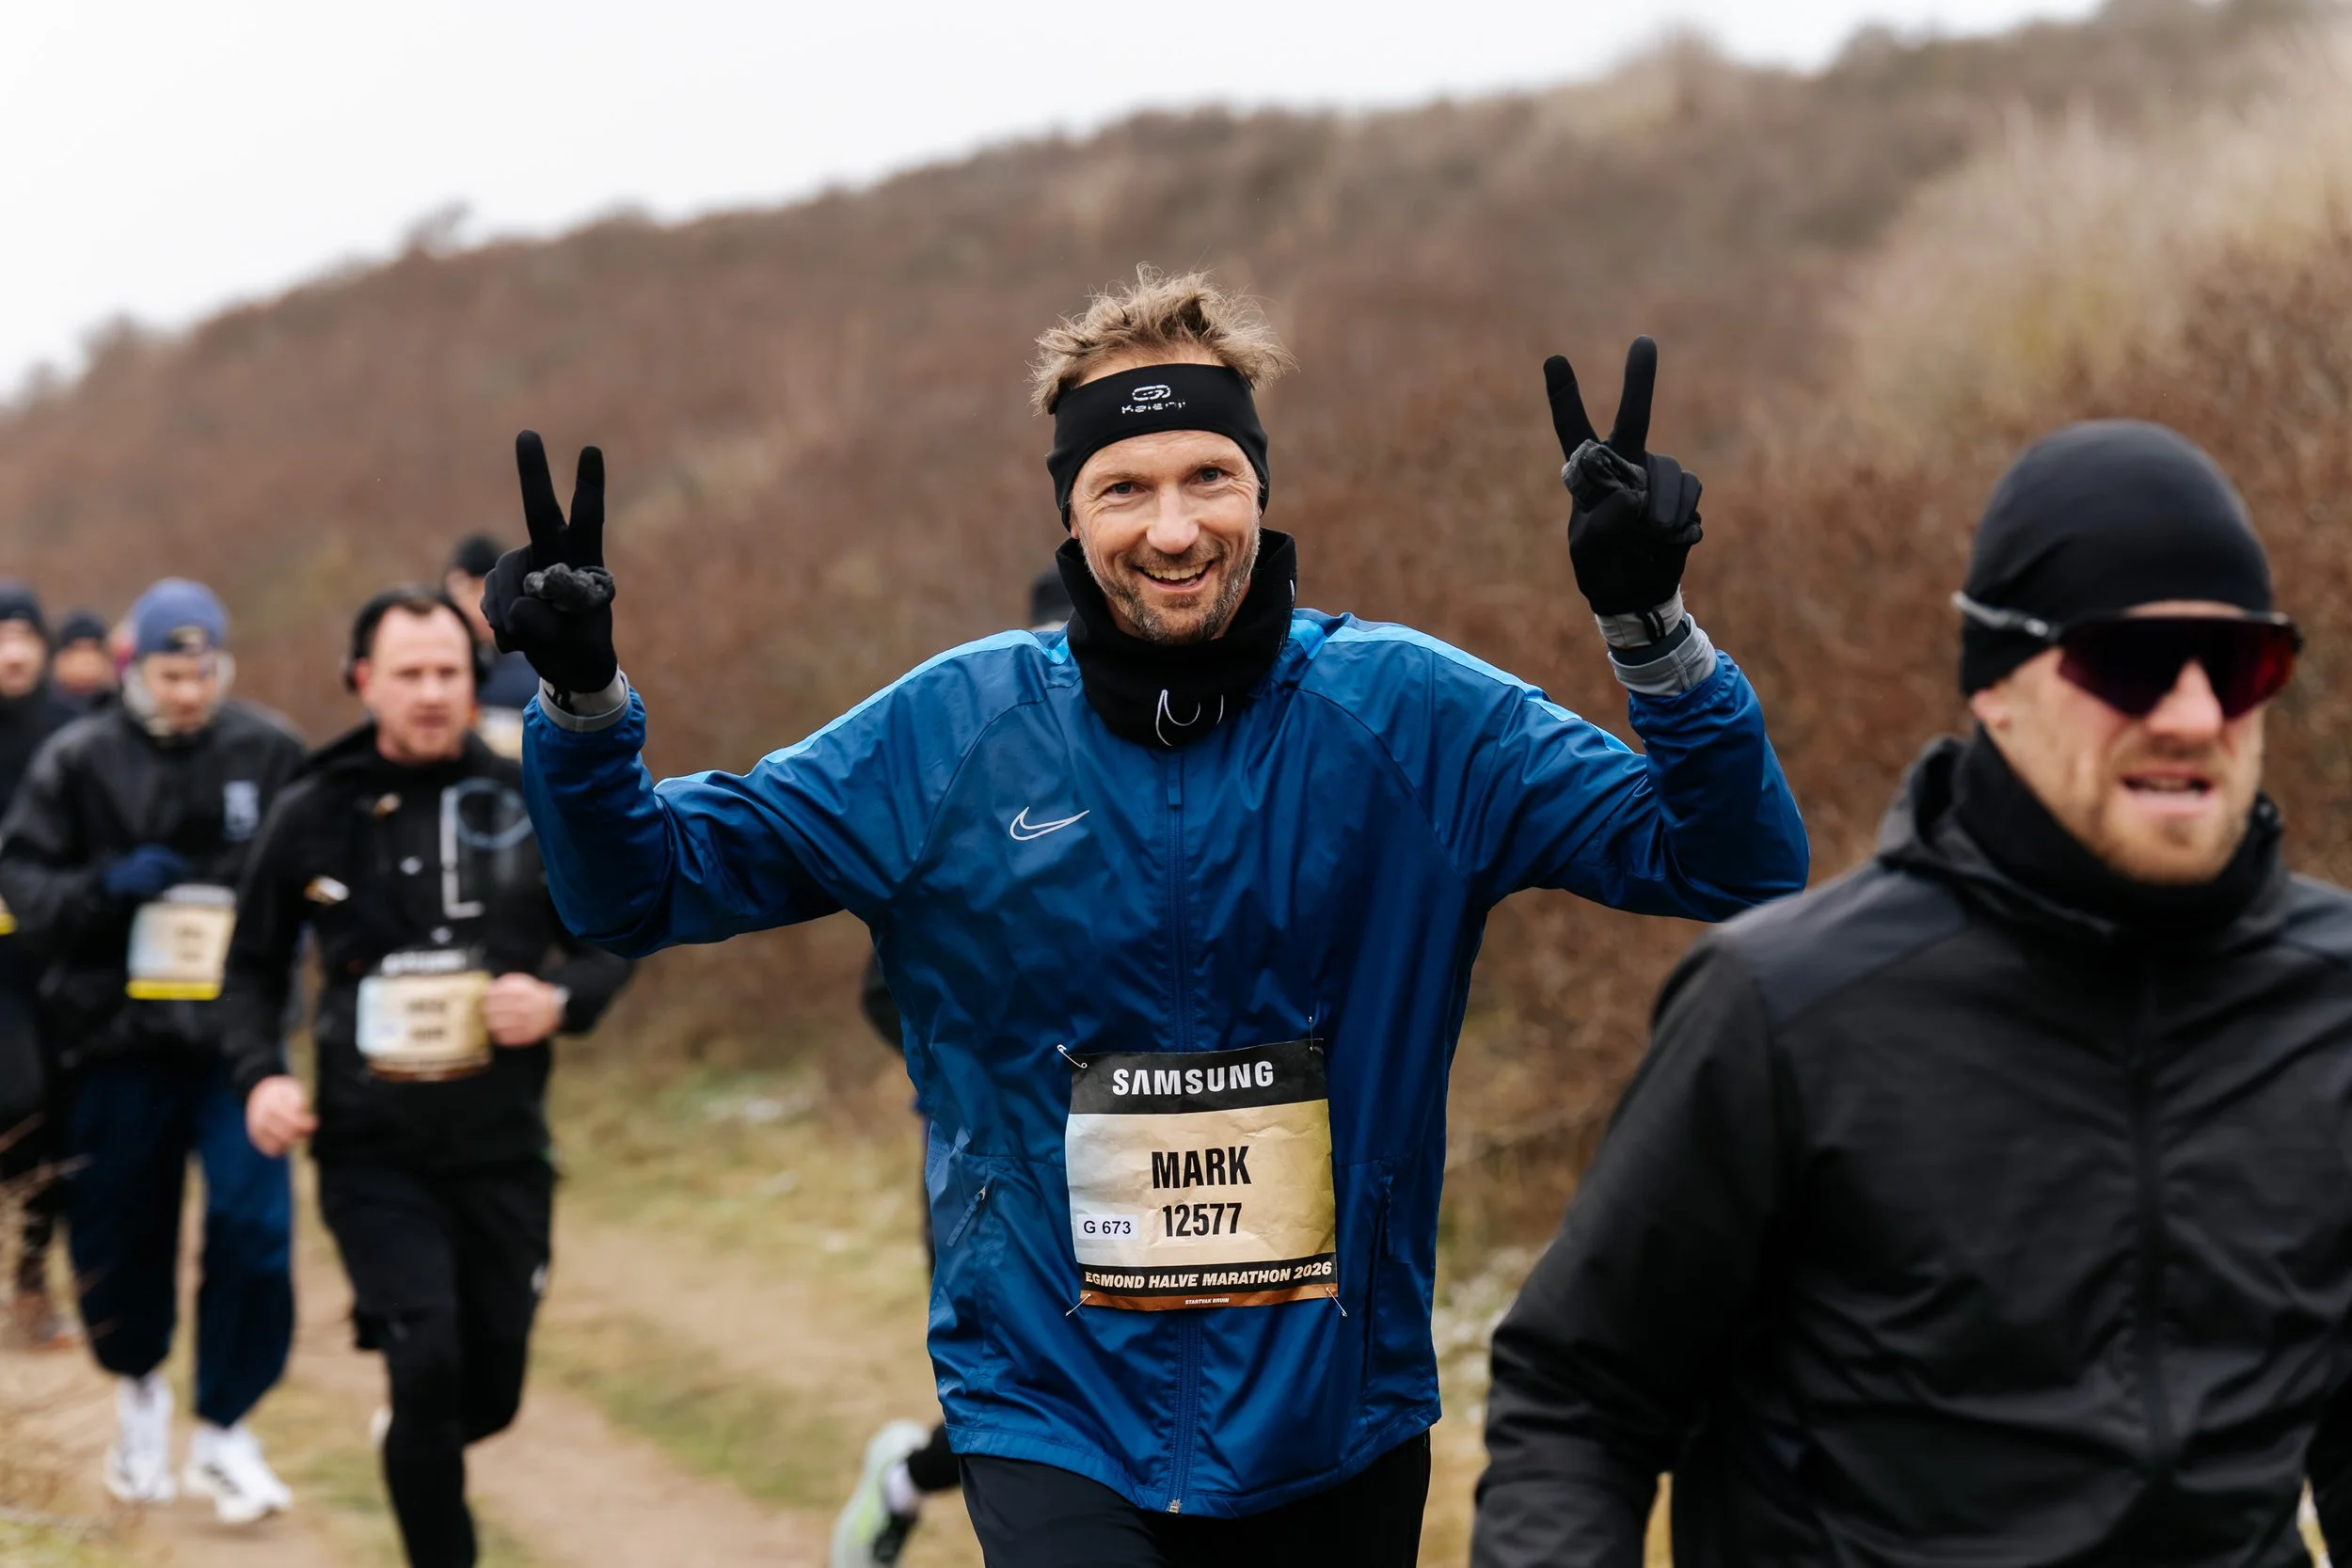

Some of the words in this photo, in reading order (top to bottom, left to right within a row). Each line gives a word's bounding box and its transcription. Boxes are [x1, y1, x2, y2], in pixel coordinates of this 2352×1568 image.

[1112, 1060, 1274, 1096] SAMSUNG
[1151, 1146, 1252, 1189] MARK
[1083, 1221, 1096, 1234] G
[1102, 1220, 1132, 1234] 673
[1162, 1202, 1243, 1237] 12577
[1085, 1271, 1145, 1289] EGMOND
[1148, 1273, 1199, 1288] HALVE
[1202, 1267, 1291, 1286] MARATHON
[1293, 1260, 1332, 1280] 2026
